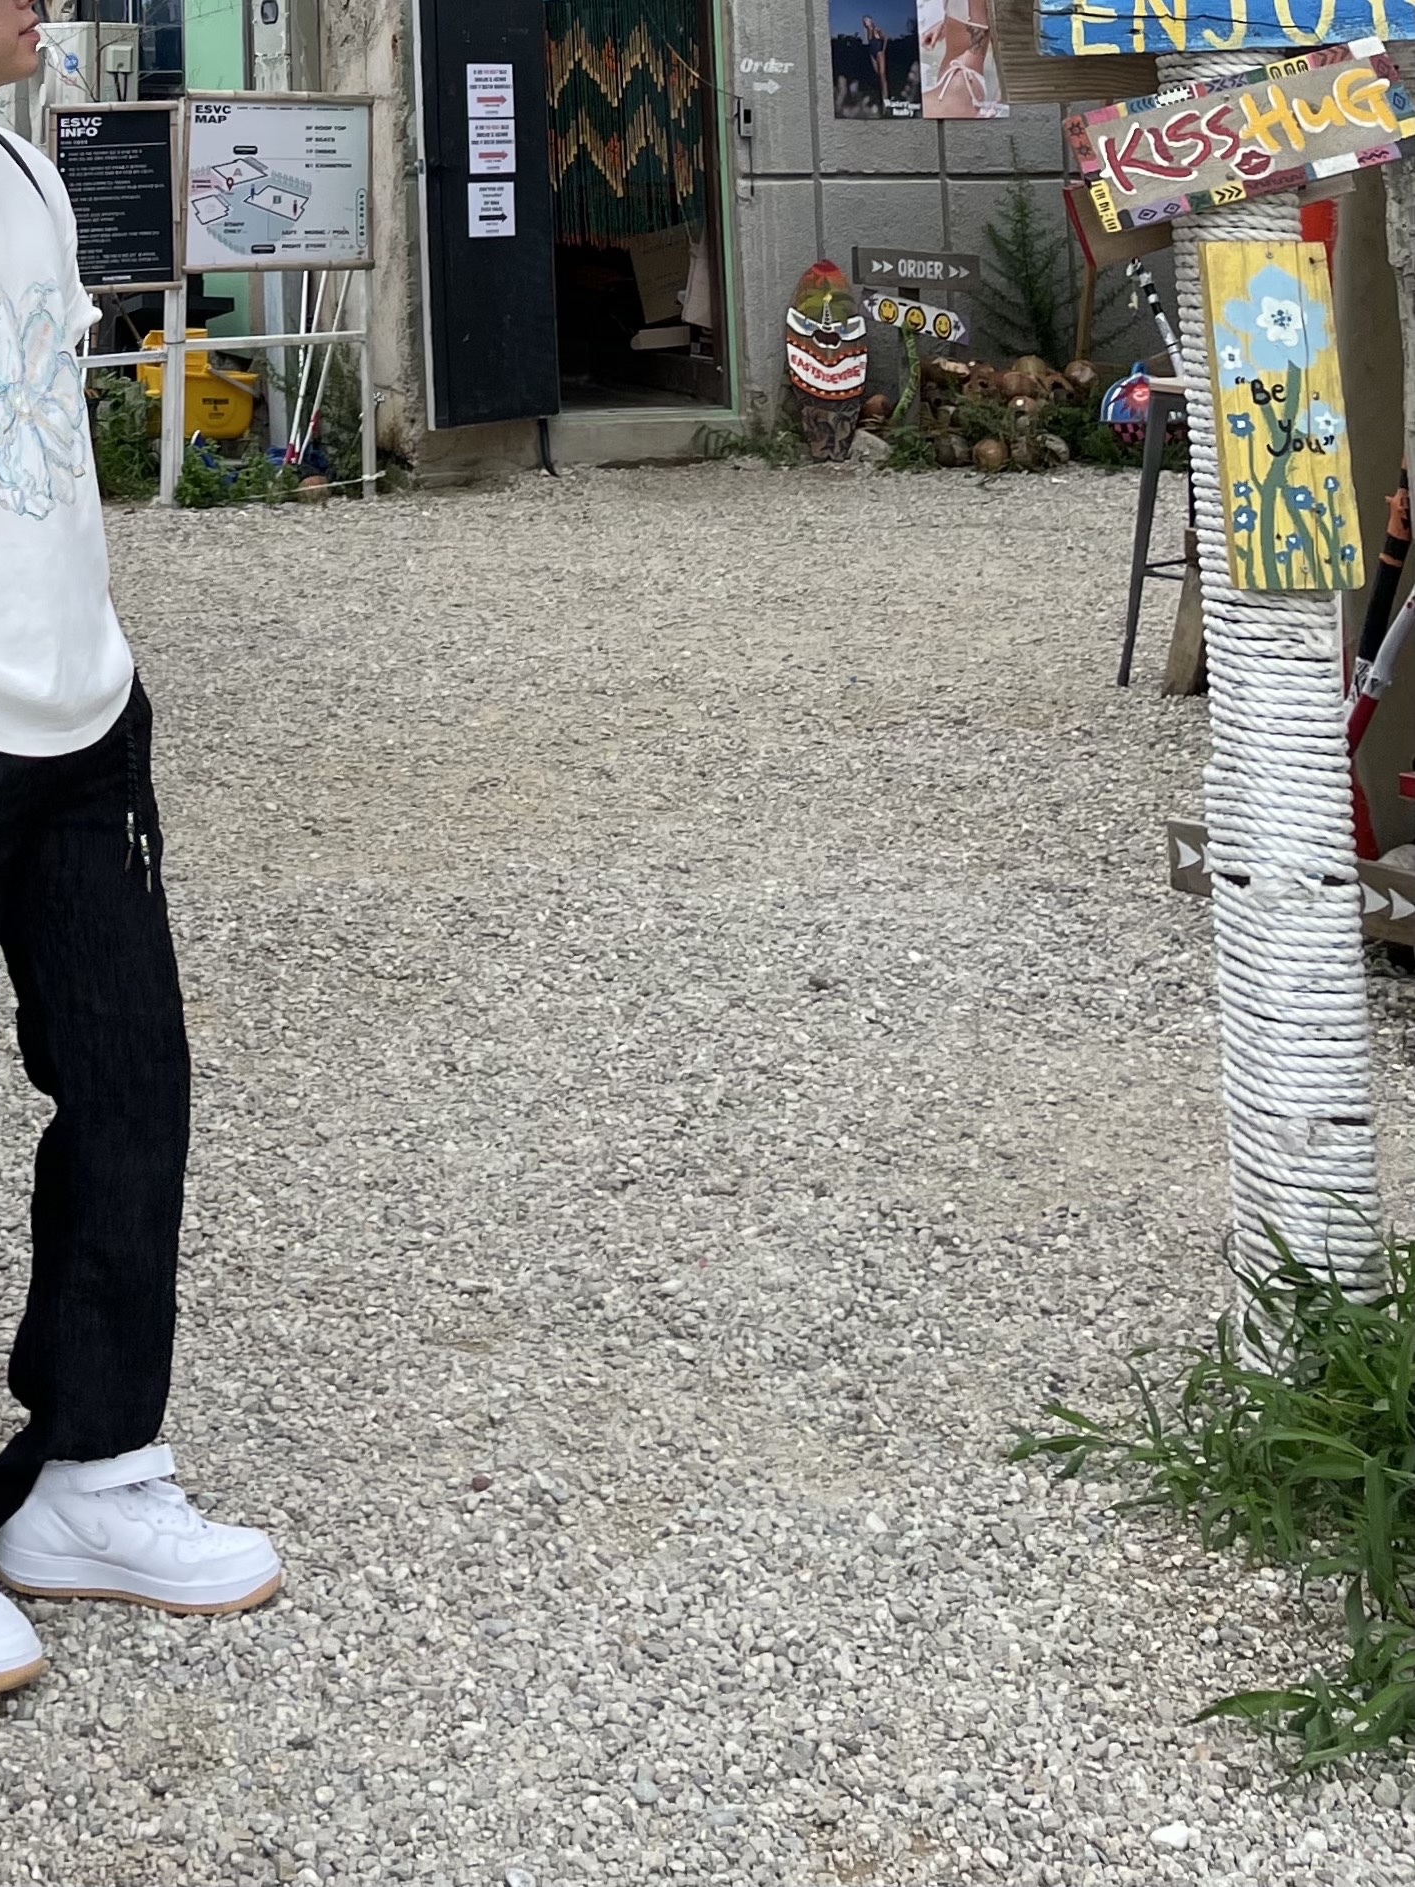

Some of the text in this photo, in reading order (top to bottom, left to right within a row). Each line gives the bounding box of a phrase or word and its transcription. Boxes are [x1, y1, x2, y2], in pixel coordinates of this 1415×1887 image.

[740, 56, 794, 76] Order
[195, 104, 232, 114] ESVC
[60, 116, 103, 128] ESVC
[194, 114, 228, 124] MAP
[60, 127, 98, 138] INFO
[1098, 103, 1242, 195] KISS
[897, 256, 944, 281] ORDER
